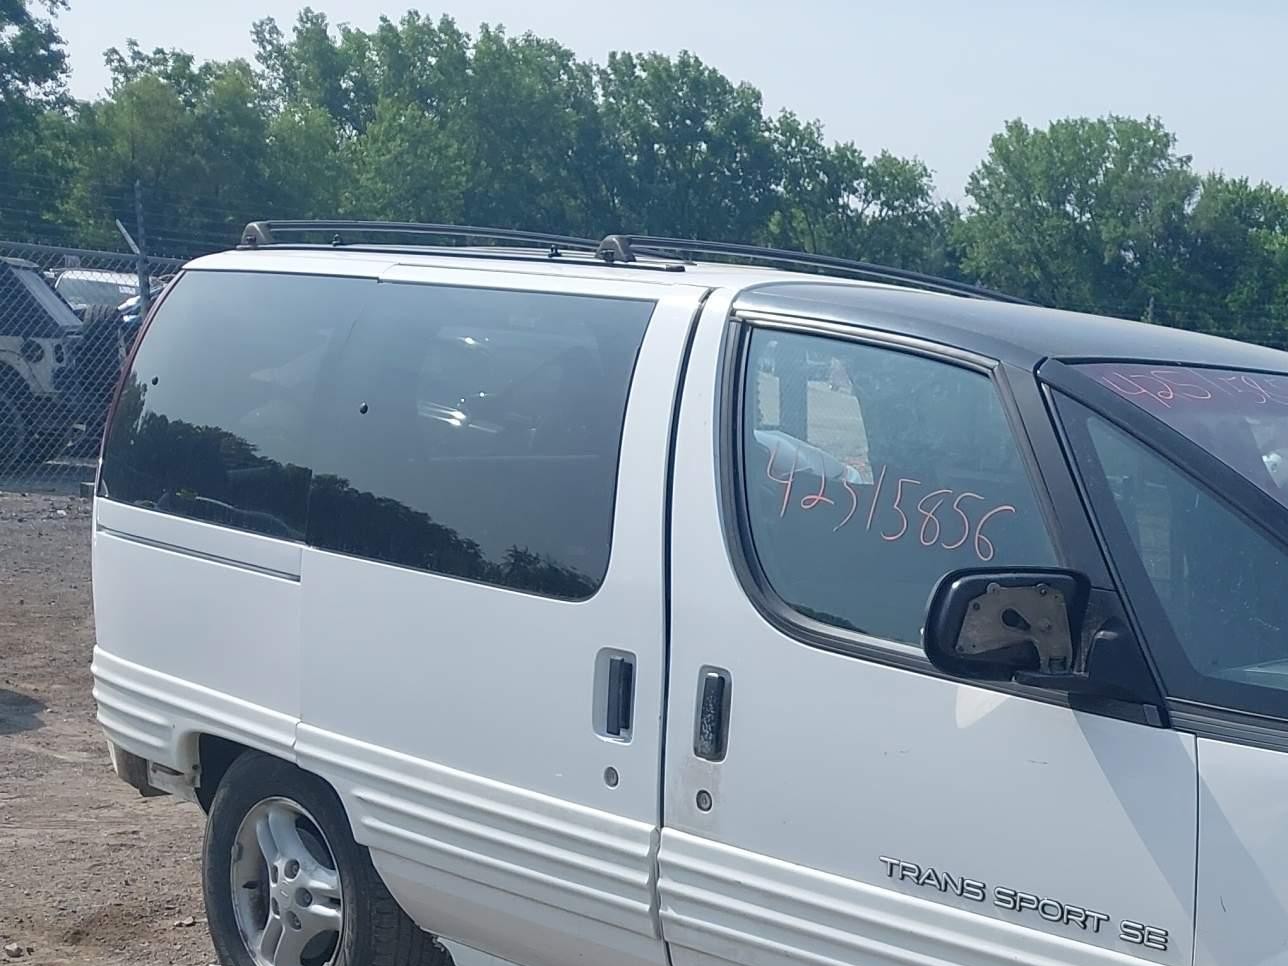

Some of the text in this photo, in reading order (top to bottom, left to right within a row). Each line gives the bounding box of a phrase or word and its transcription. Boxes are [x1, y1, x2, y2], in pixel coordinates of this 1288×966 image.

[766, 441, 1016, 562] 42515856
[878, 855, 1170, 952] TRANS SPORT SE
